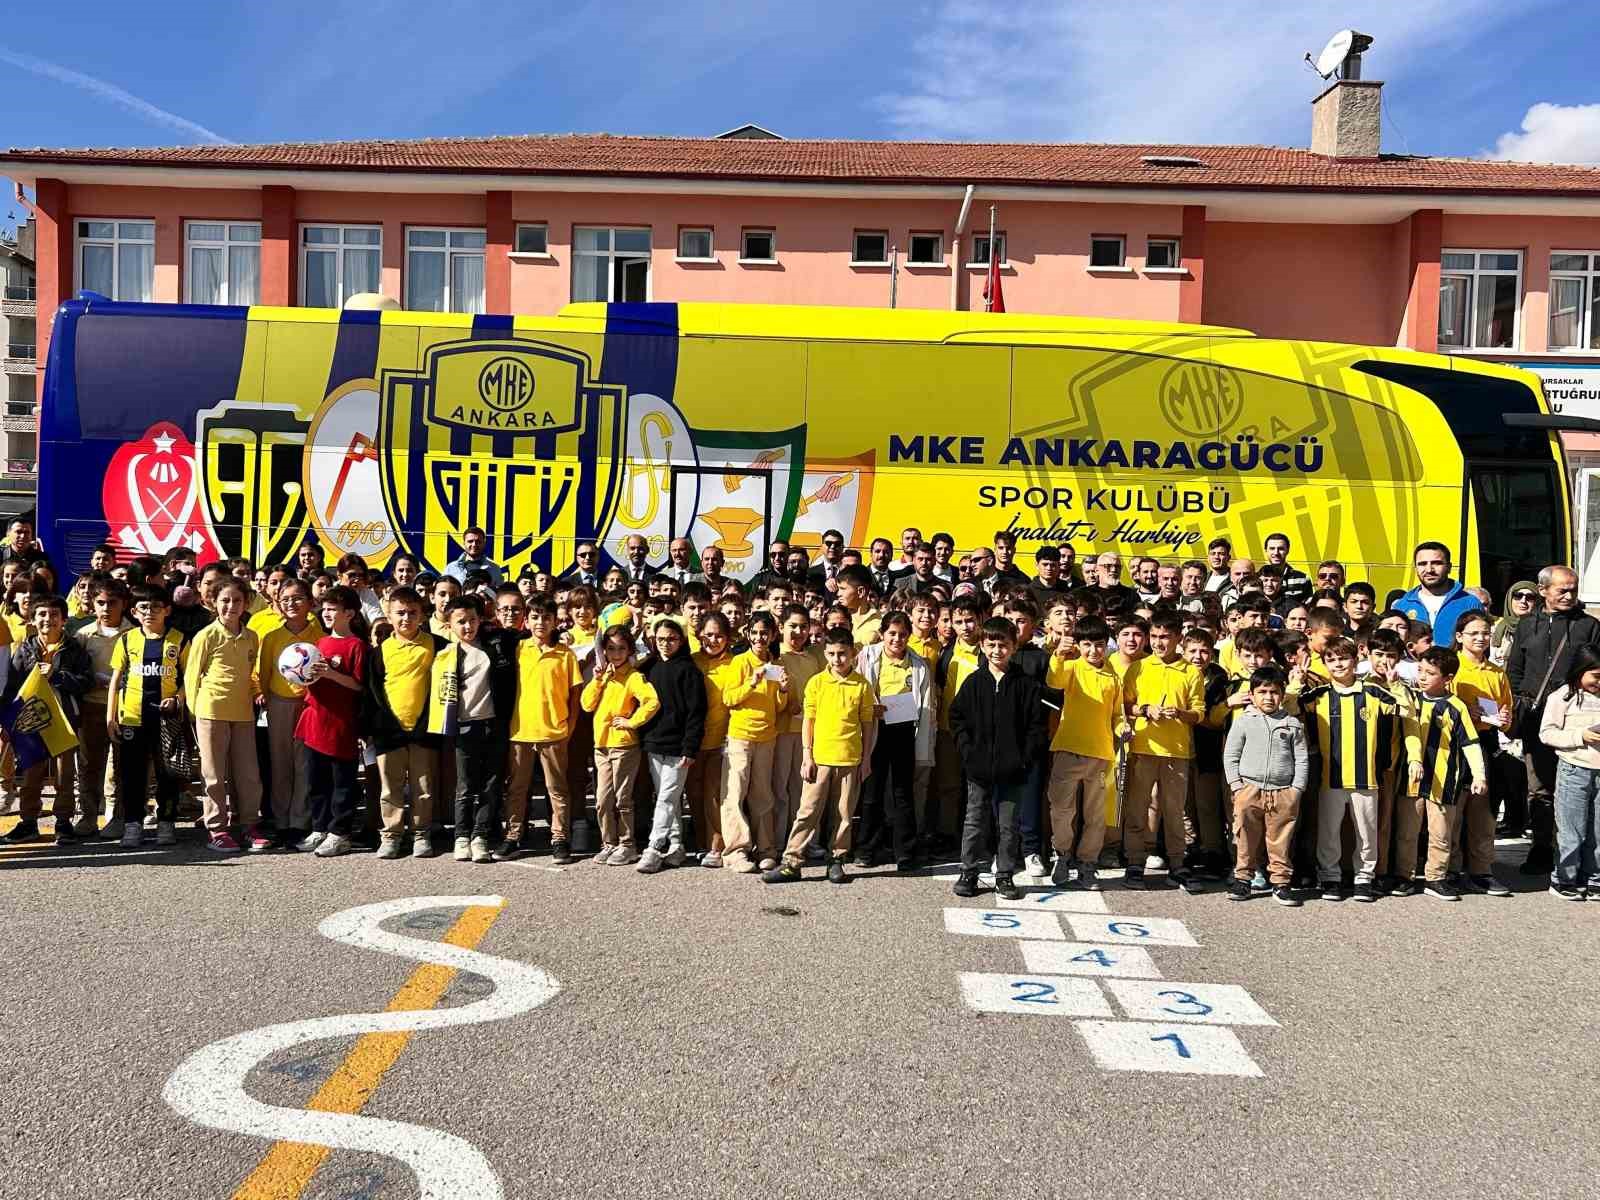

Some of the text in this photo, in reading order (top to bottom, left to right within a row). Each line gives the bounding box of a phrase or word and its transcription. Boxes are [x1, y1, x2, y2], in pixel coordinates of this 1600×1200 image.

[485, 363, 528, 406] MKE
[1546, 387, 1600, 400] RTUĞRU
[451, 405, 556, 427] ANKARA
[889, 434, 985, 464] MKE
[999, 434, 1324, 473] ANKARAGÜCÜ
[978, 484, 1230, 514] SPOR KULÜBÜ
[337, 520, 387, 547] 1910
[1103, 519, 1202, 552] Harbiye
[981, 913, 1149, 937] 5 6
[1071, 949, 1117, 967] 4
[1012, 981, 1213, 1015] 2 3
